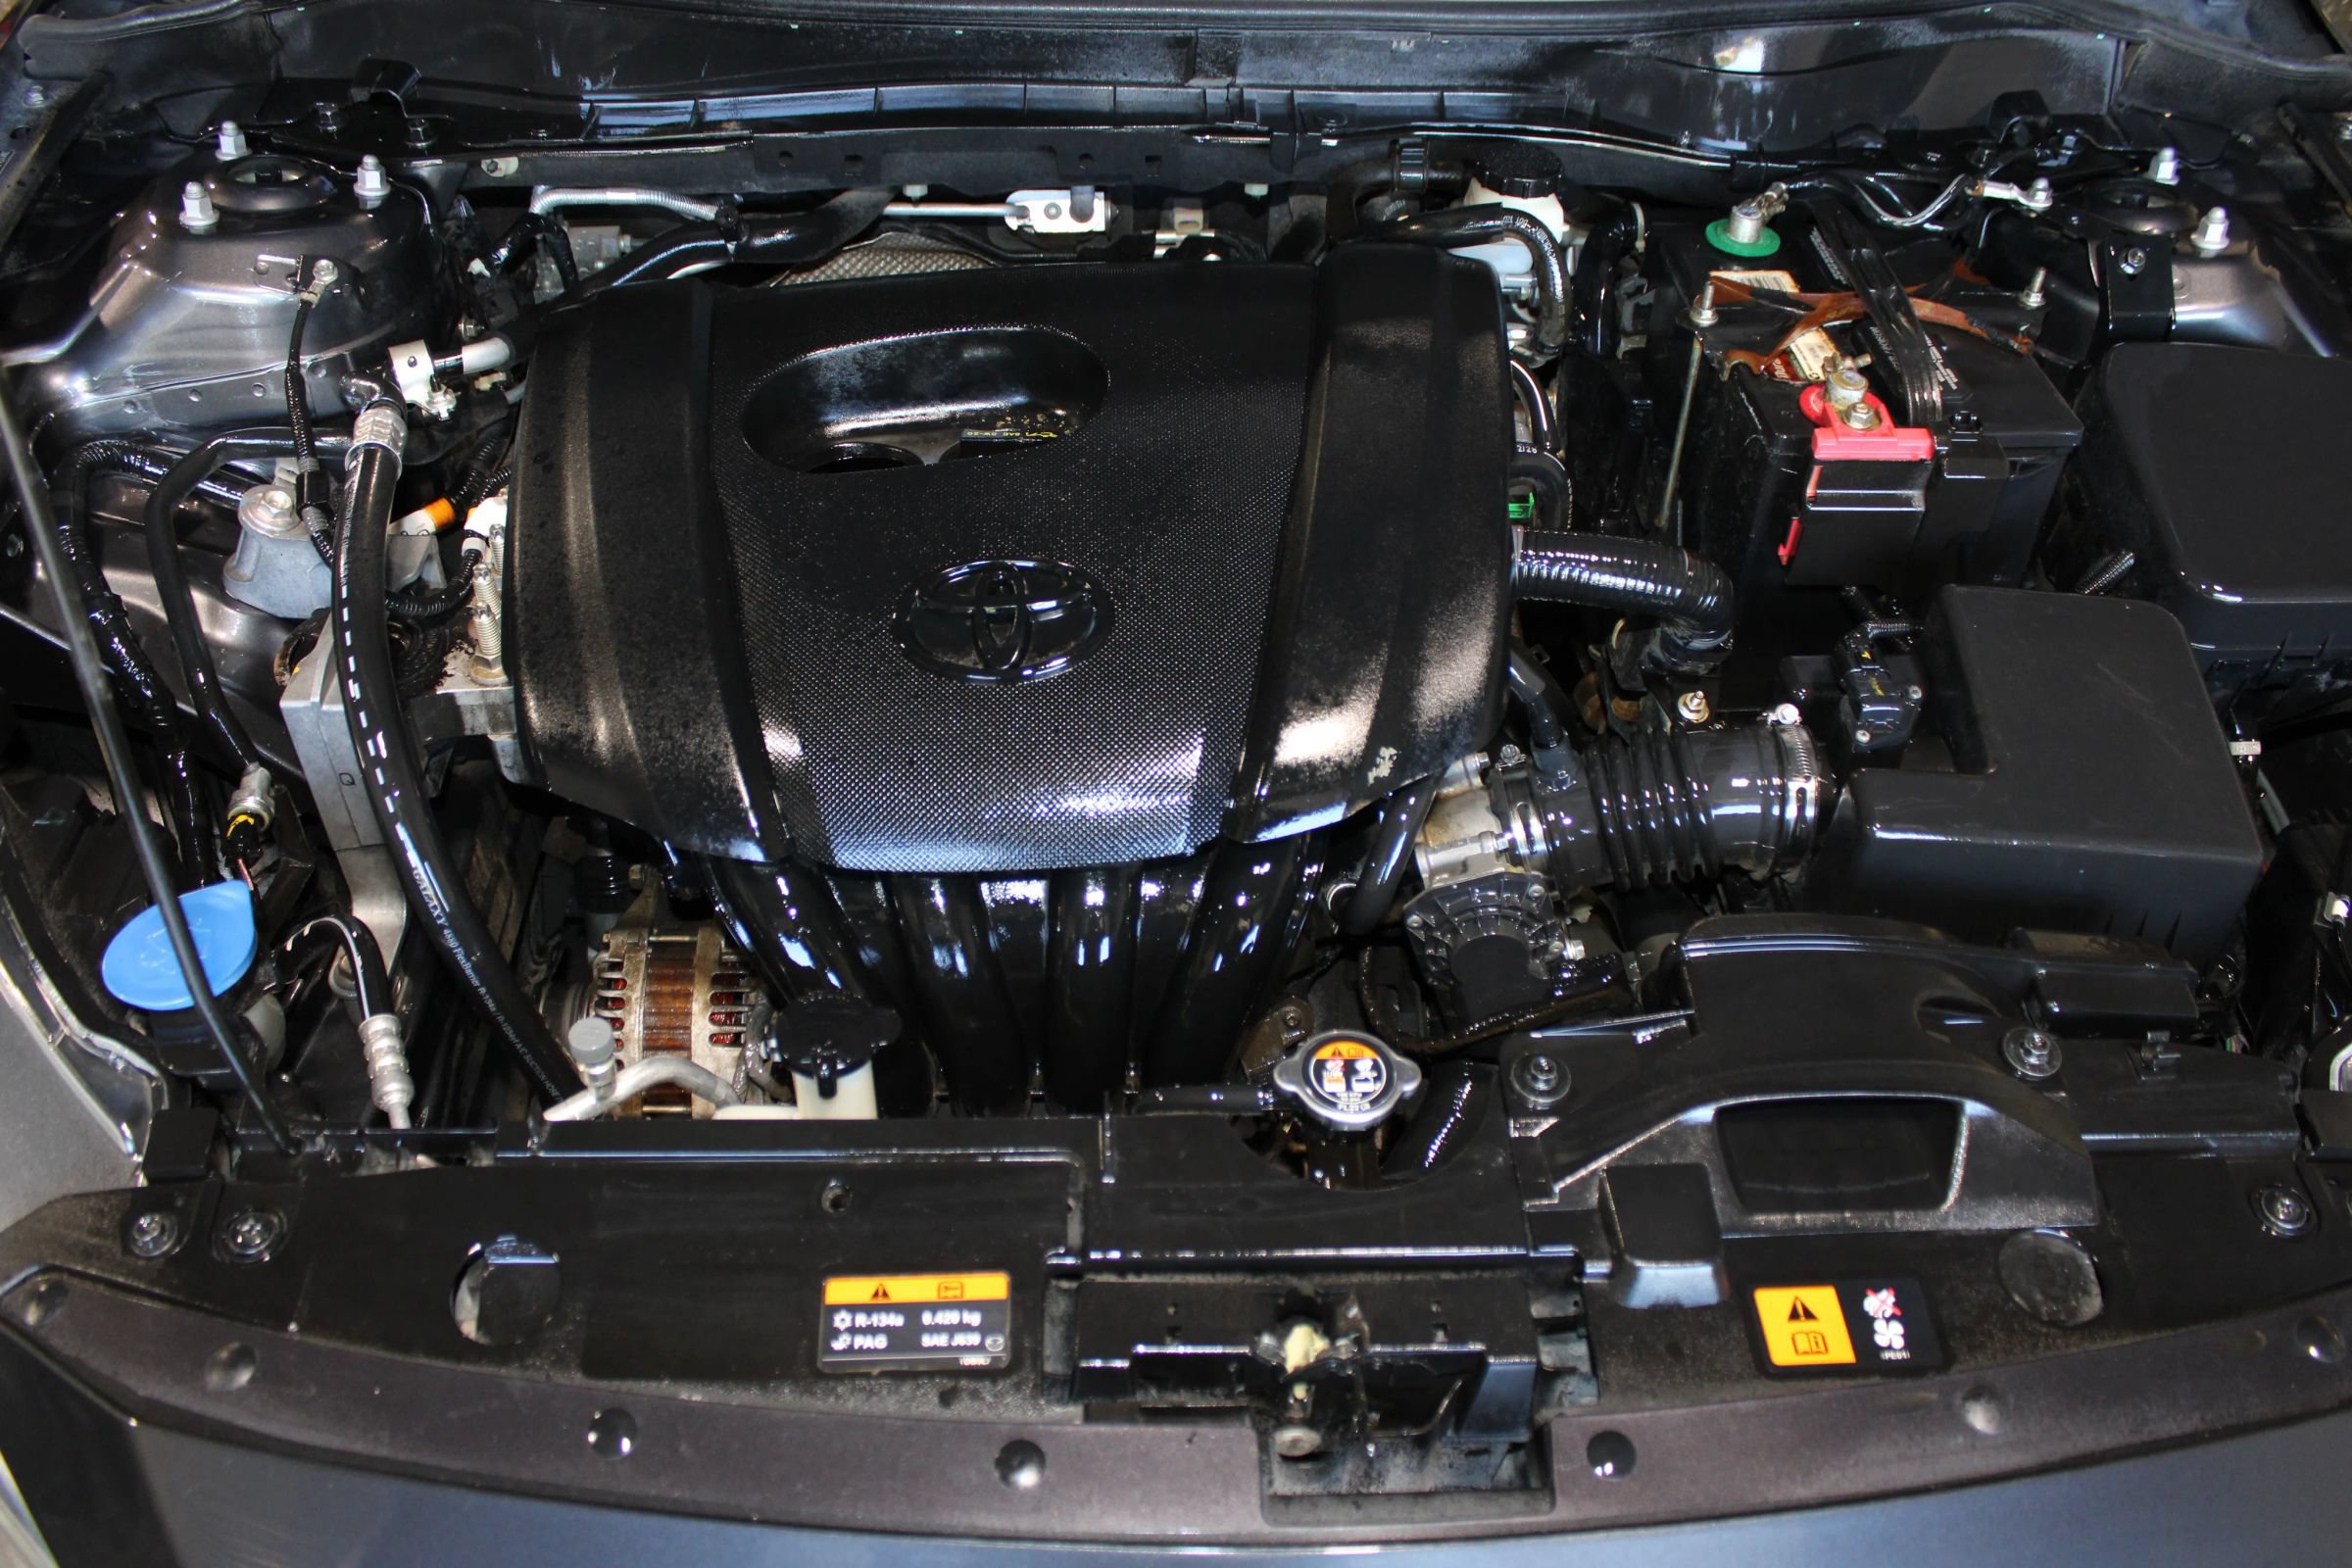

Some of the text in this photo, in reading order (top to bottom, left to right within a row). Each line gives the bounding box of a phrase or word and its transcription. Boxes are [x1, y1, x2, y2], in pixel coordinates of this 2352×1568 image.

[413, 869, 449, 926] GALAXY
[451, 947, 481, 988] FlexBarrier
[476, 986, 497, 1013] R-134a
[855, 1311, 906, 1328] R-134a
[961, 1309, 982, 1328] kg
[854, 1333, 889, 1350] PAG
[920, 1332, 950, 1348] SAE
